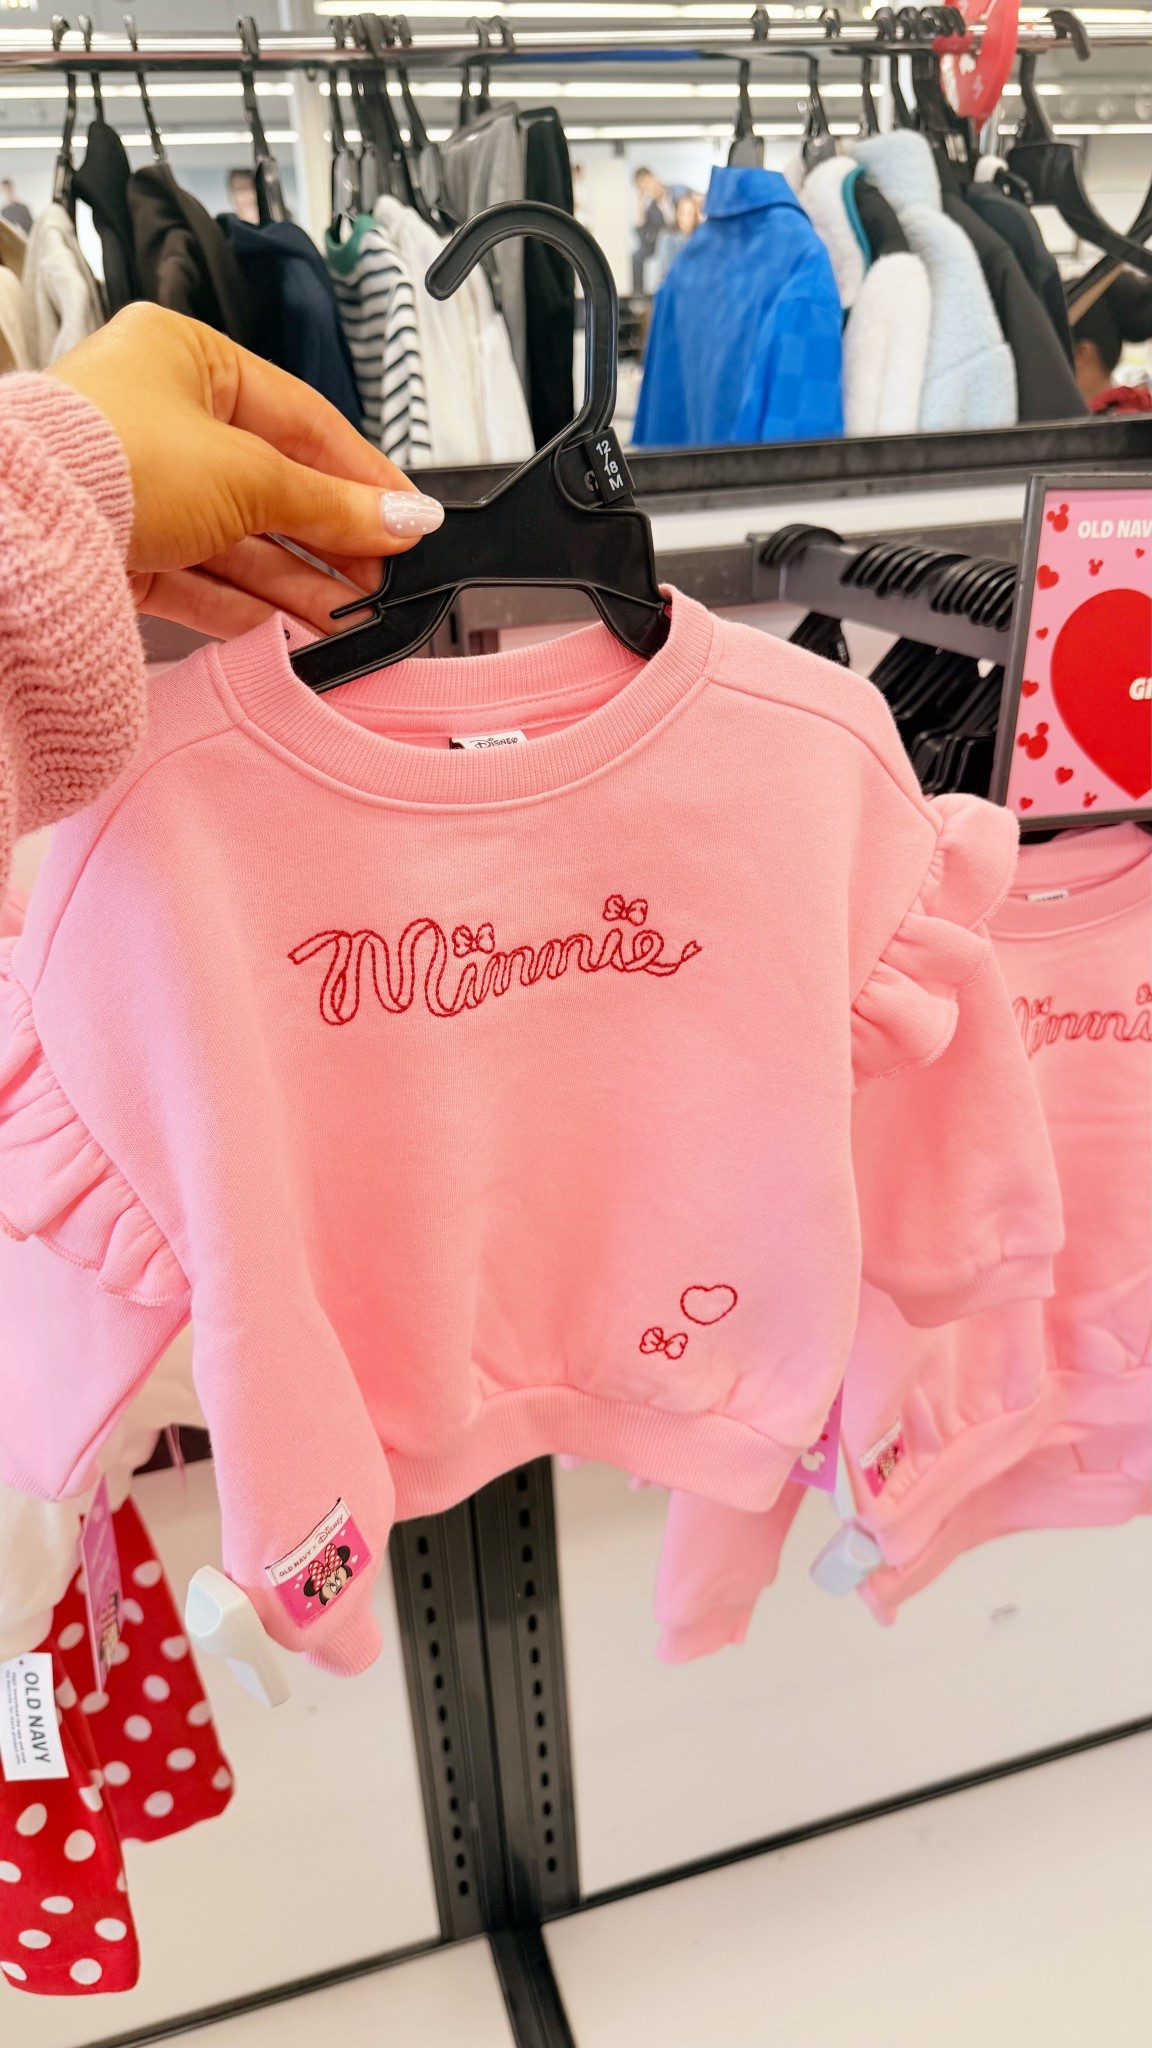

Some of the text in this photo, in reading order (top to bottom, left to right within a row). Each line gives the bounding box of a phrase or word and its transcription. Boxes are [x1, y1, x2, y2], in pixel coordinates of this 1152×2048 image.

[595, 440, 612, 456] 12
[604, 461, 619, 476] 18
[609, 474, 624, 491] M
[1077, 520, 1114, 539] OLD
[287, 894, 703, 1026] Minnie
[279, 1565, 293, 1577] OLD
[294, 1549, 312, 1568] NAVY
[24, 1671, 52, 1763] OLD NAVY
